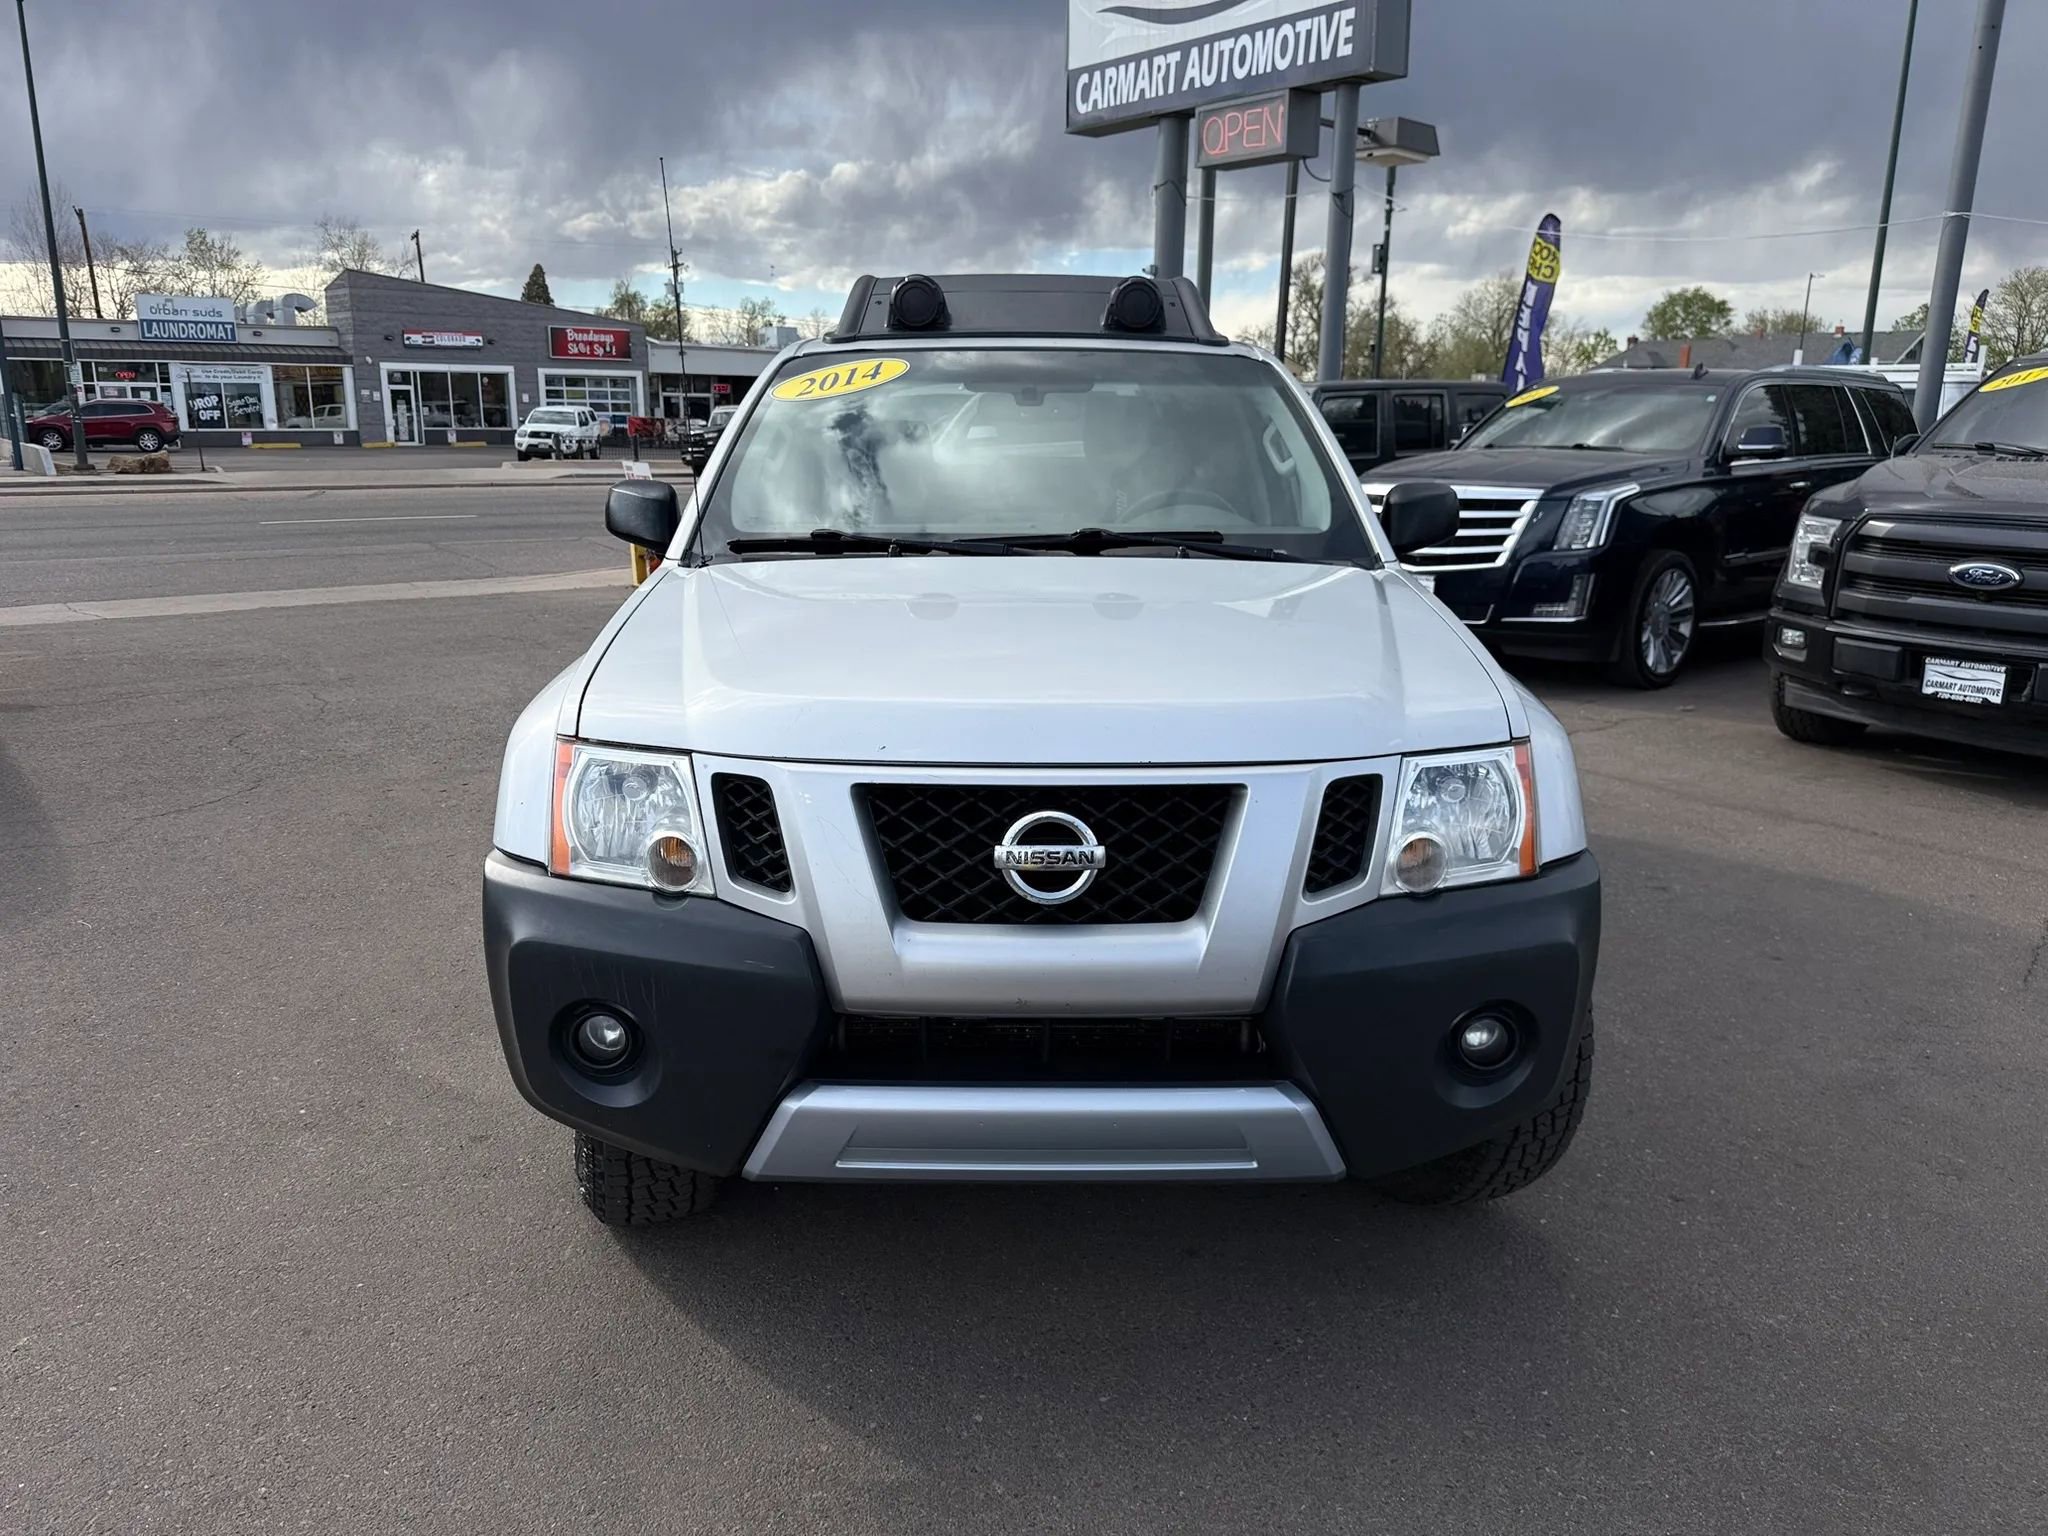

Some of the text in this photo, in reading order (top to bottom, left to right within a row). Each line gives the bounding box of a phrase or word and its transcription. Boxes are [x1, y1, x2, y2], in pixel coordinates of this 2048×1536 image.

[1074, 7, 1356, 115] CARMART AUTOMOTIVE
[1202, 103, 1285, 156] OPEN
[192, 308, 223, 318] suds
[142, 321, 233, 340] LAUNDROMAT
[115, 371, 136, 379] OPEN
[796, 361, 884, 398] 2014
[199, 410, 221, 421] OFF
[1964, 567, 2003, 585] Ford
[1925, 657, 2007, 673] CARMART AUTOMOTIVE
[1925, 679, 2001, 697] CARMART AUTOMOTIVE
[1005, 850, 1095, 865] NISSAN
